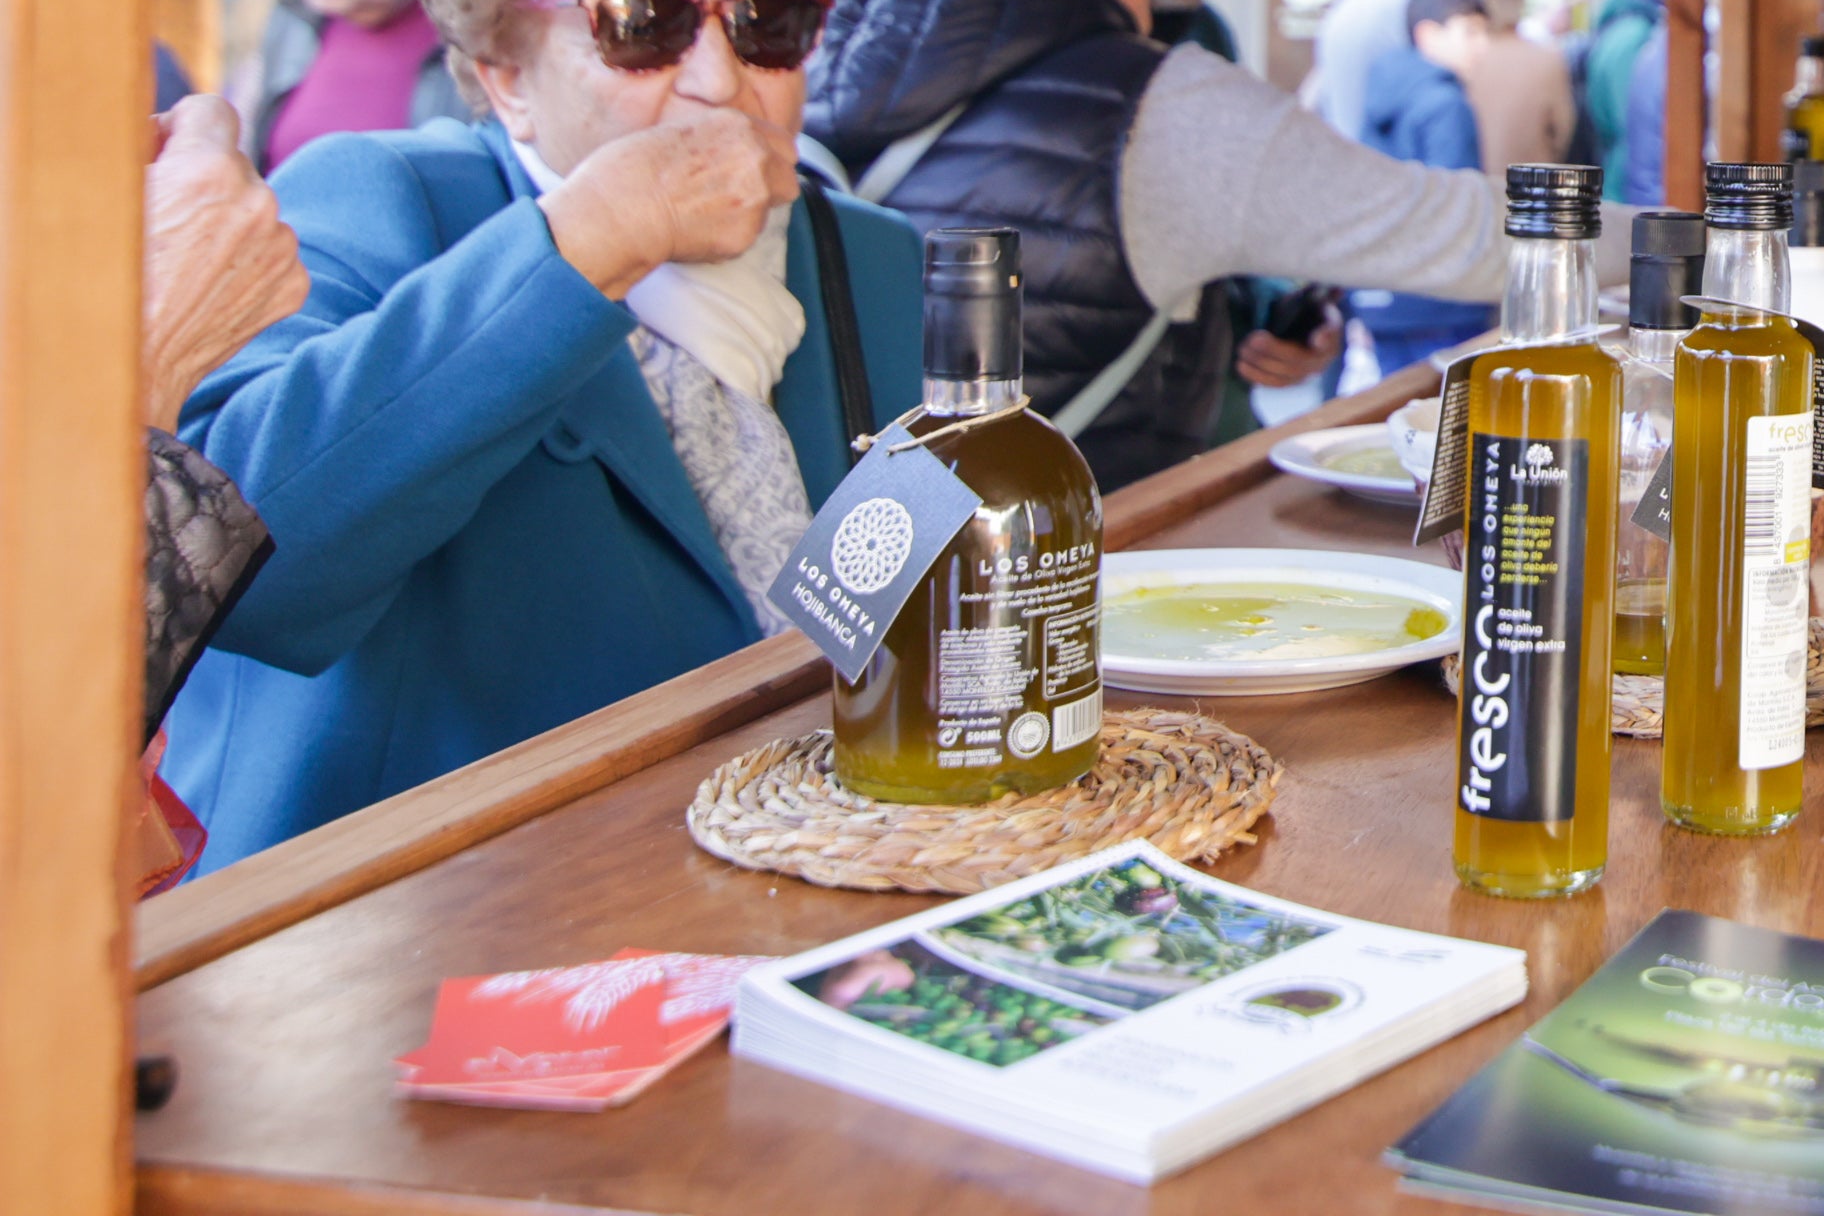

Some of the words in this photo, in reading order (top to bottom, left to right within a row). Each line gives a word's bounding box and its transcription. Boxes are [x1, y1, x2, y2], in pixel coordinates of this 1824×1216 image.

[1510, 464, 1526, 480] La
[1529, 463, 1568, 480] Unión
[1775, 460, 1785, 499] 927333
[1483, 442, 1501, 535] OMEYA
[1502, 514, 1556, 527] experiencia
[1501, 526, 1520, 538] que
[1521, 527, 1551, 540] ningún
[1502, 538, 1535, 549] amante
[1536, 538, 1552, 550] del
[979, 555, 1029, 577] LOS
[1039, 541, 1095, 569] OMEYA
[1501, 549, 1530, 560] aceite
[1530, 550, 1543, 561] de
[990, 572, 1019, 584] Aceite
[1020, 571, 1033, 581] de
[1034, 569, 1056, 581] Oliva
[1056, 563, 1078, 577] Virgen
[1481, 544, 1496, 600] LOS
[1500, 560, 1522, 572] oliva
[797, 556, 829, 591] LOS
[829, 586, 876, 637] OMEYA
[791, 581, 858, 652] HOJIBLANCA
[1498, 608, 1533, 620] aceite
[1497, 621, 1514, 635] de
[1515, 622, 1544, 636] oliva
[1497, 637, 1534, 653] virgen
[1535, 638, 1566, 652] extra
[1462, 604, 1512, 812] fresco
[967, 718, 977, 727] de
[965, 728, 1003, 745] 500ML
[1657, 953, 1745, 981] Festival
[1750, 973, 1791, 989] del
